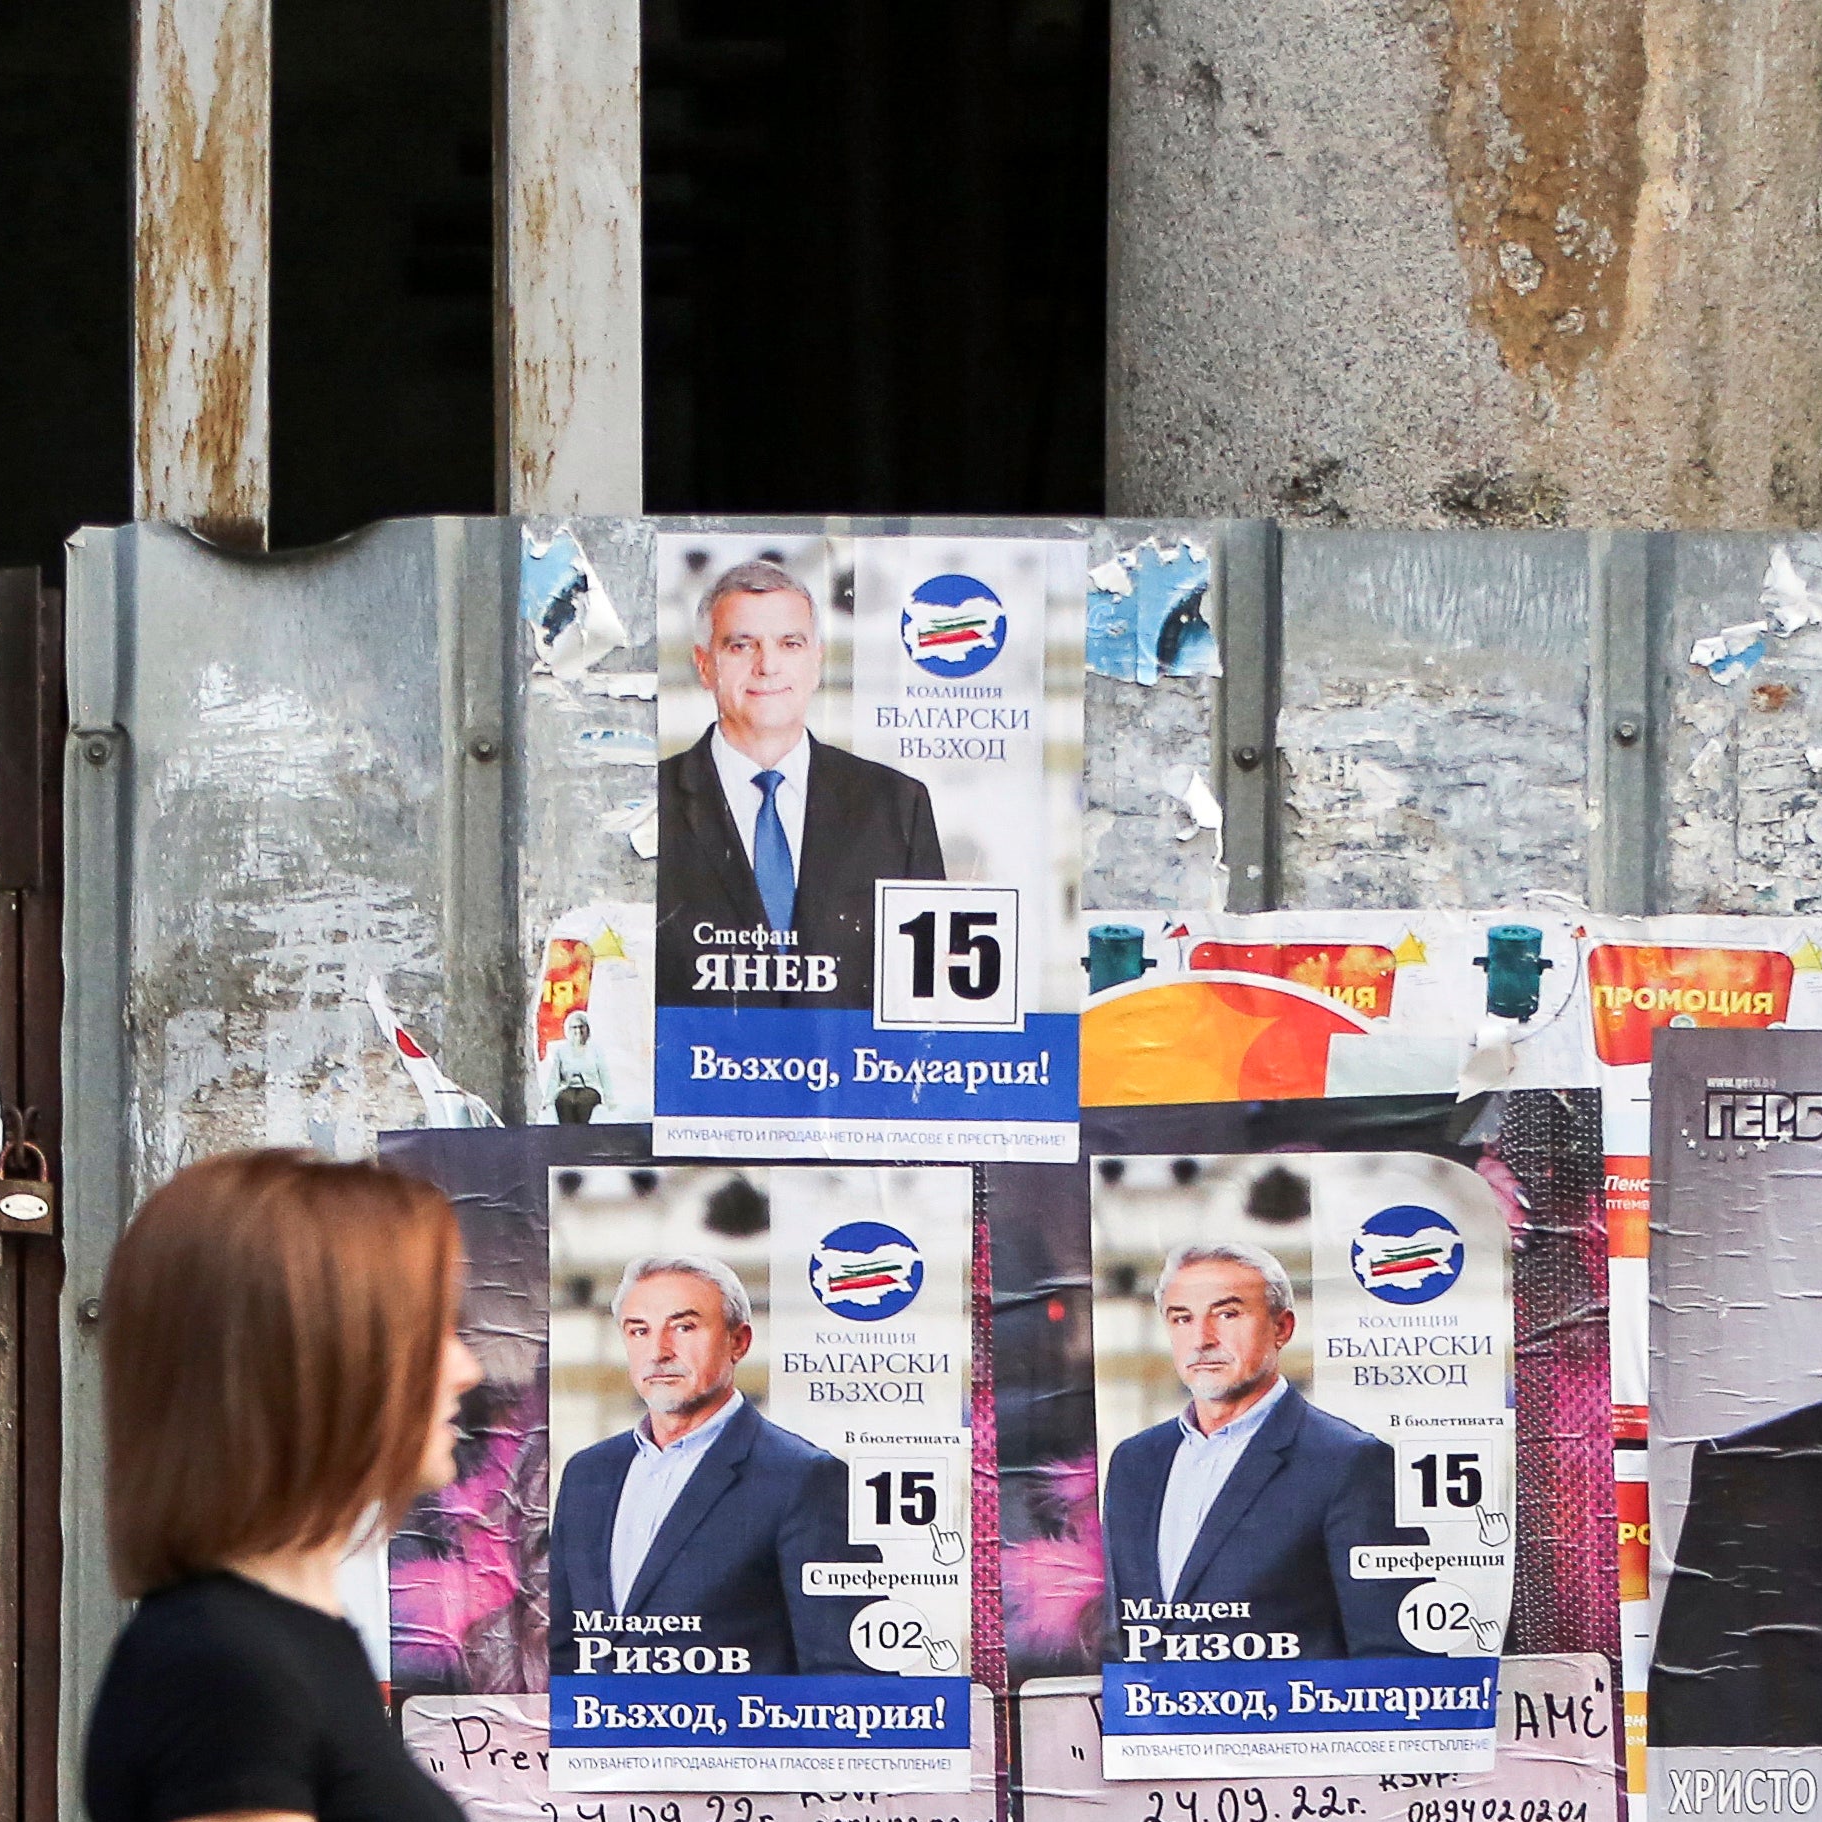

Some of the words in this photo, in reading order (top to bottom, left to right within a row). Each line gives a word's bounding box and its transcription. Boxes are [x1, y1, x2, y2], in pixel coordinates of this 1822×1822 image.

[906, 685, 1003, 700] КОАЛИЦИЯ
[876, 706, 1030, 731] БЪЛГАРСКИ
[899, 738, 1007, 762] ВЪЗХОД
[692, 922, 799, 949] Стефан
[898, 911, 1001, 1000] 15
[692, 954, 839, 992] ЯНЕВ
[1594, 985, 1774, 1016] ПРОМОЦИЯ
[690, 1045, 840, 1090] Възход,
[853, 1049, 1050, 1090] България!
[845, 1431, 853, 1443] В
[857, 1432, 960, 1445] бюлетината
[866, 1471, 938, 1526] 15
[810, 1571, 823, 1585] С
[827, 1570, 959, 1589] преференция
[572, 1610, 702, 1634] Младен
[857, 1623, 923, 1648] 102
[573, 1635, 751, 1674] Ризов
[573, 1697, 728, 1732] Възход,
[738, 1697, 947, 1736] България!
[1668, 1769, 1818, 1816] ХРИСТО
